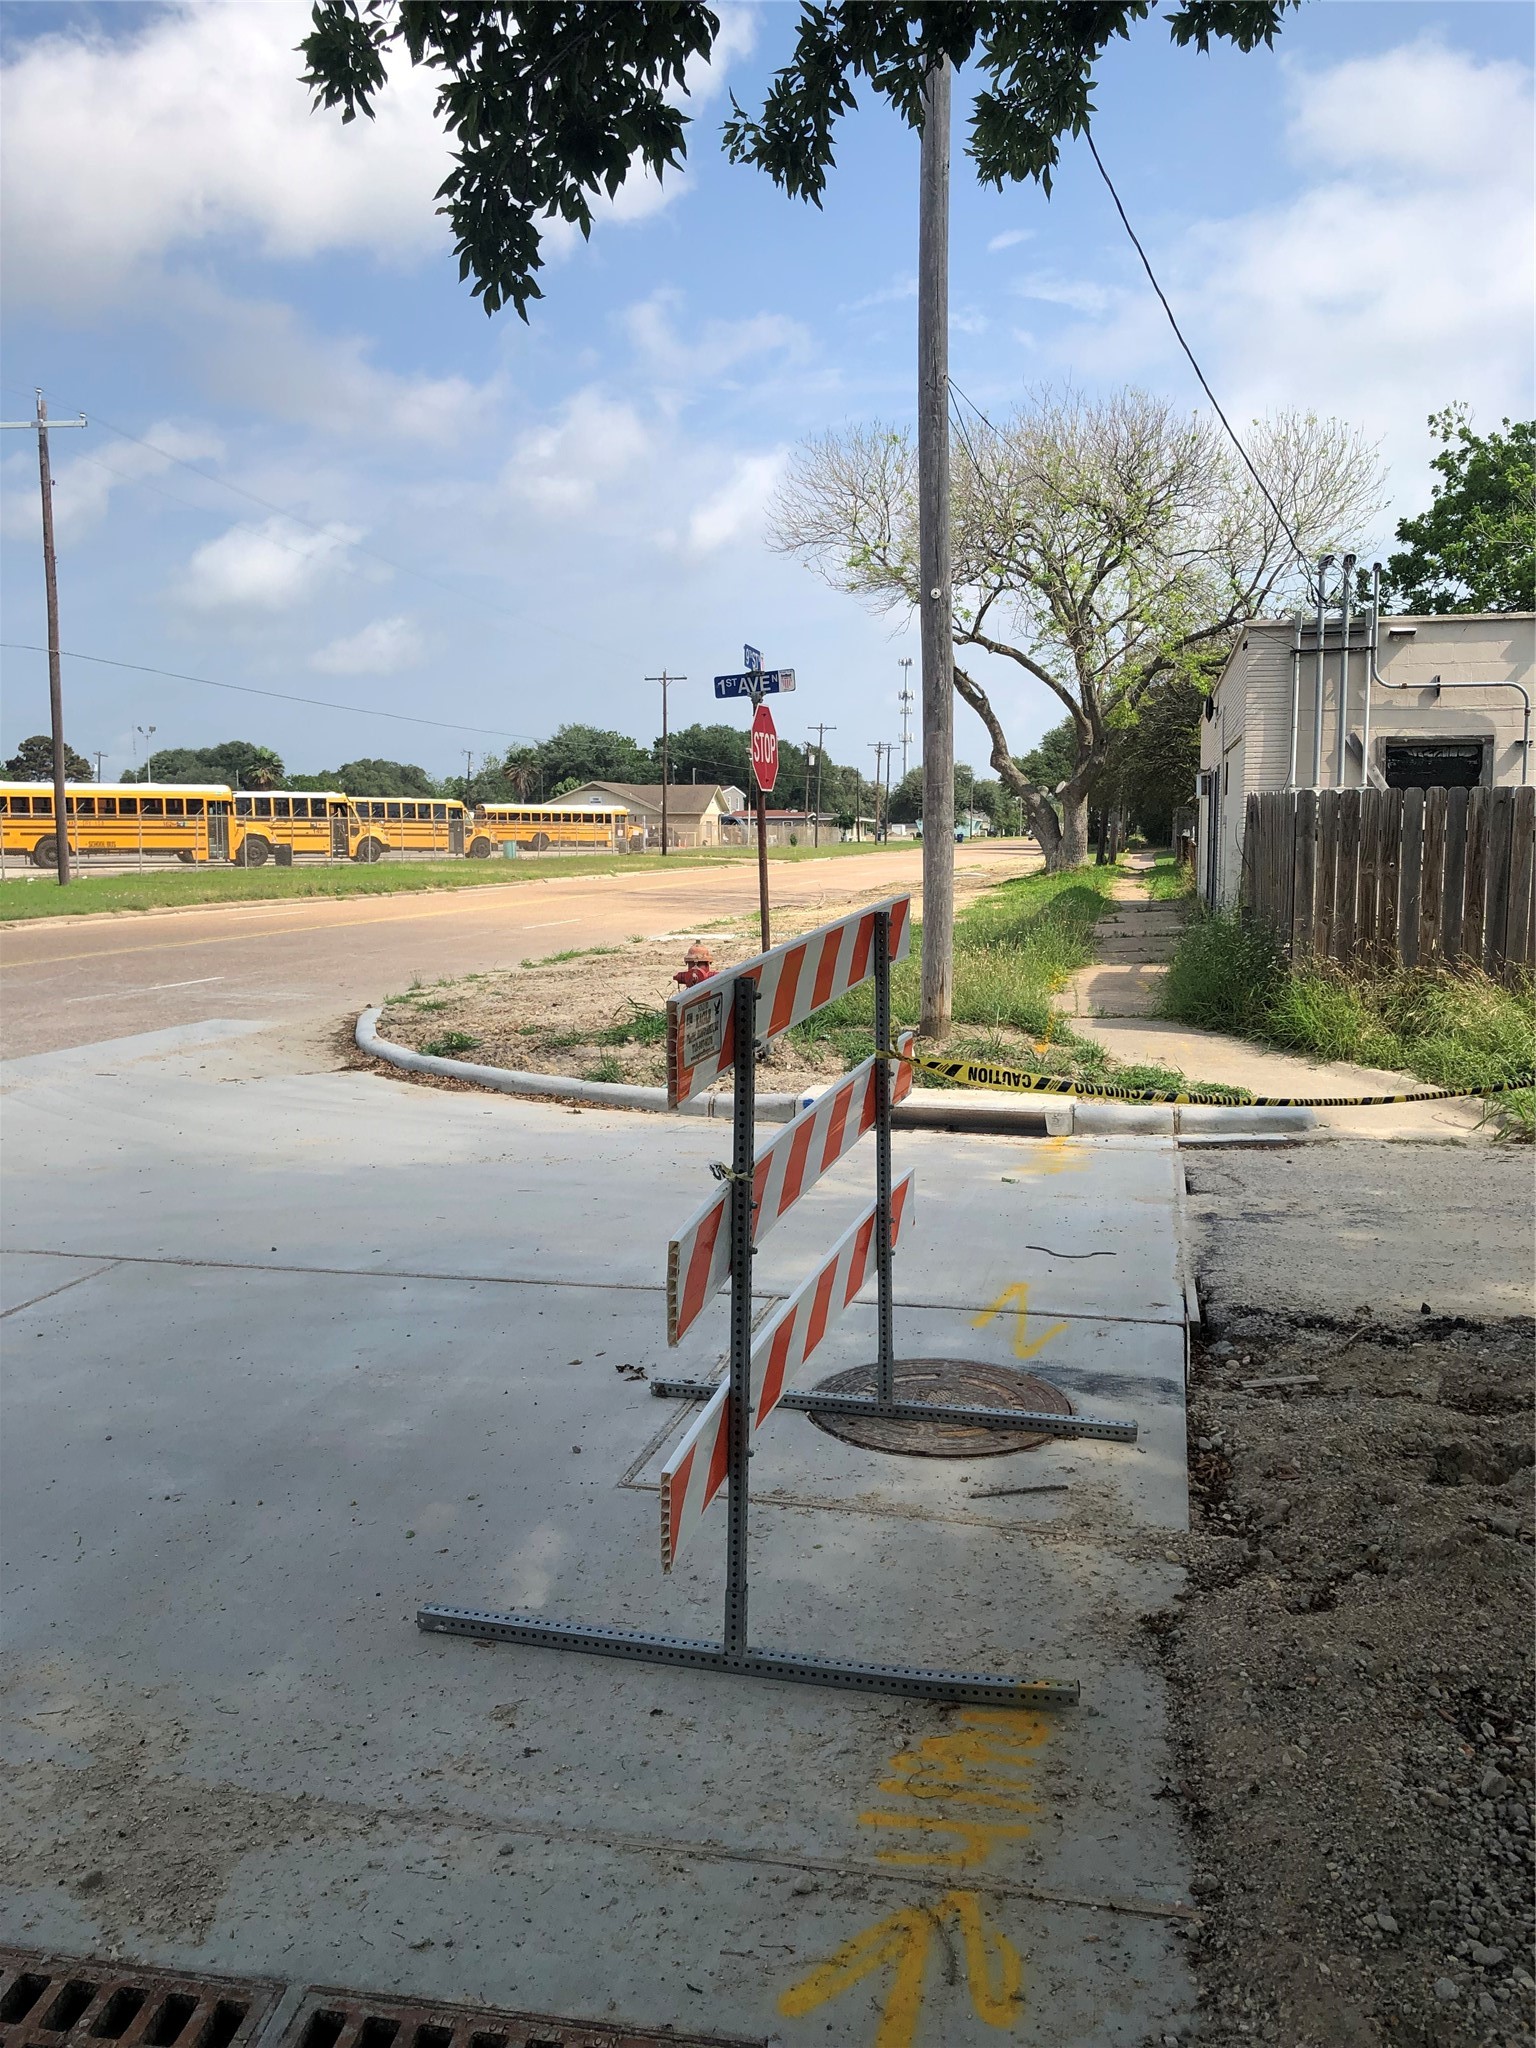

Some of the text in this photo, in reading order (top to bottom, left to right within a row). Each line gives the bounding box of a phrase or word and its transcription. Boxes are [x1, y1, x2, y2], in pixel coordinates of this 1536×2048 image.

[717, 674, 778, 695] 1ST AVE N
[753, 731, 776, 764] STOP
[967, 1066, 1032, 1089] CAUTION
